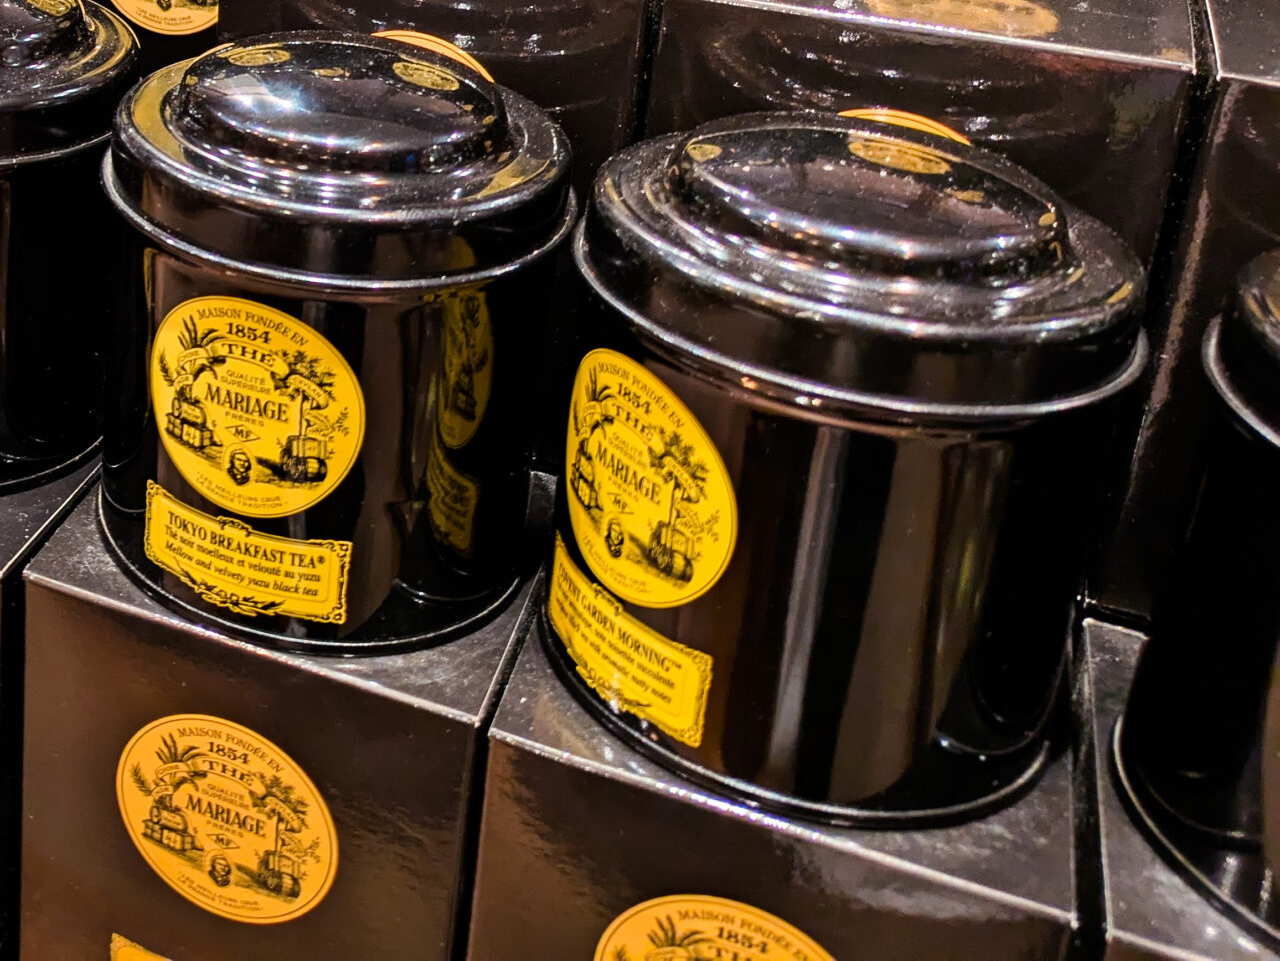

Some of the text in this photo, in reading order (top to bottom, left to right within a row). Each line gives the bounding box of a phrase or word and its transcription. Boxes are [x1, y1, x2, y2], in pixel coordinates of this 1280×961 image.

[226, 322, 272, 344] 1854
[204, 383, 289, 424] MARIAGE
[617, 382, 652, 415] 1854
[594, 441, 662, 506] MARIAGE
[168, 510, 207, 541] TOKYO
[209, 531, 285, 564] BREAKFAST
[165, 541, 318, 597] Mellow and velvety yuzu black tea
[581, 595, 615, 635] GARDEN
[206, 741, 251, 765] 1854
[185, 793, 267, 838] MARIAGE
[677, 909, 735, 925] MAISON
[716, 926, 770, 954] 1854
